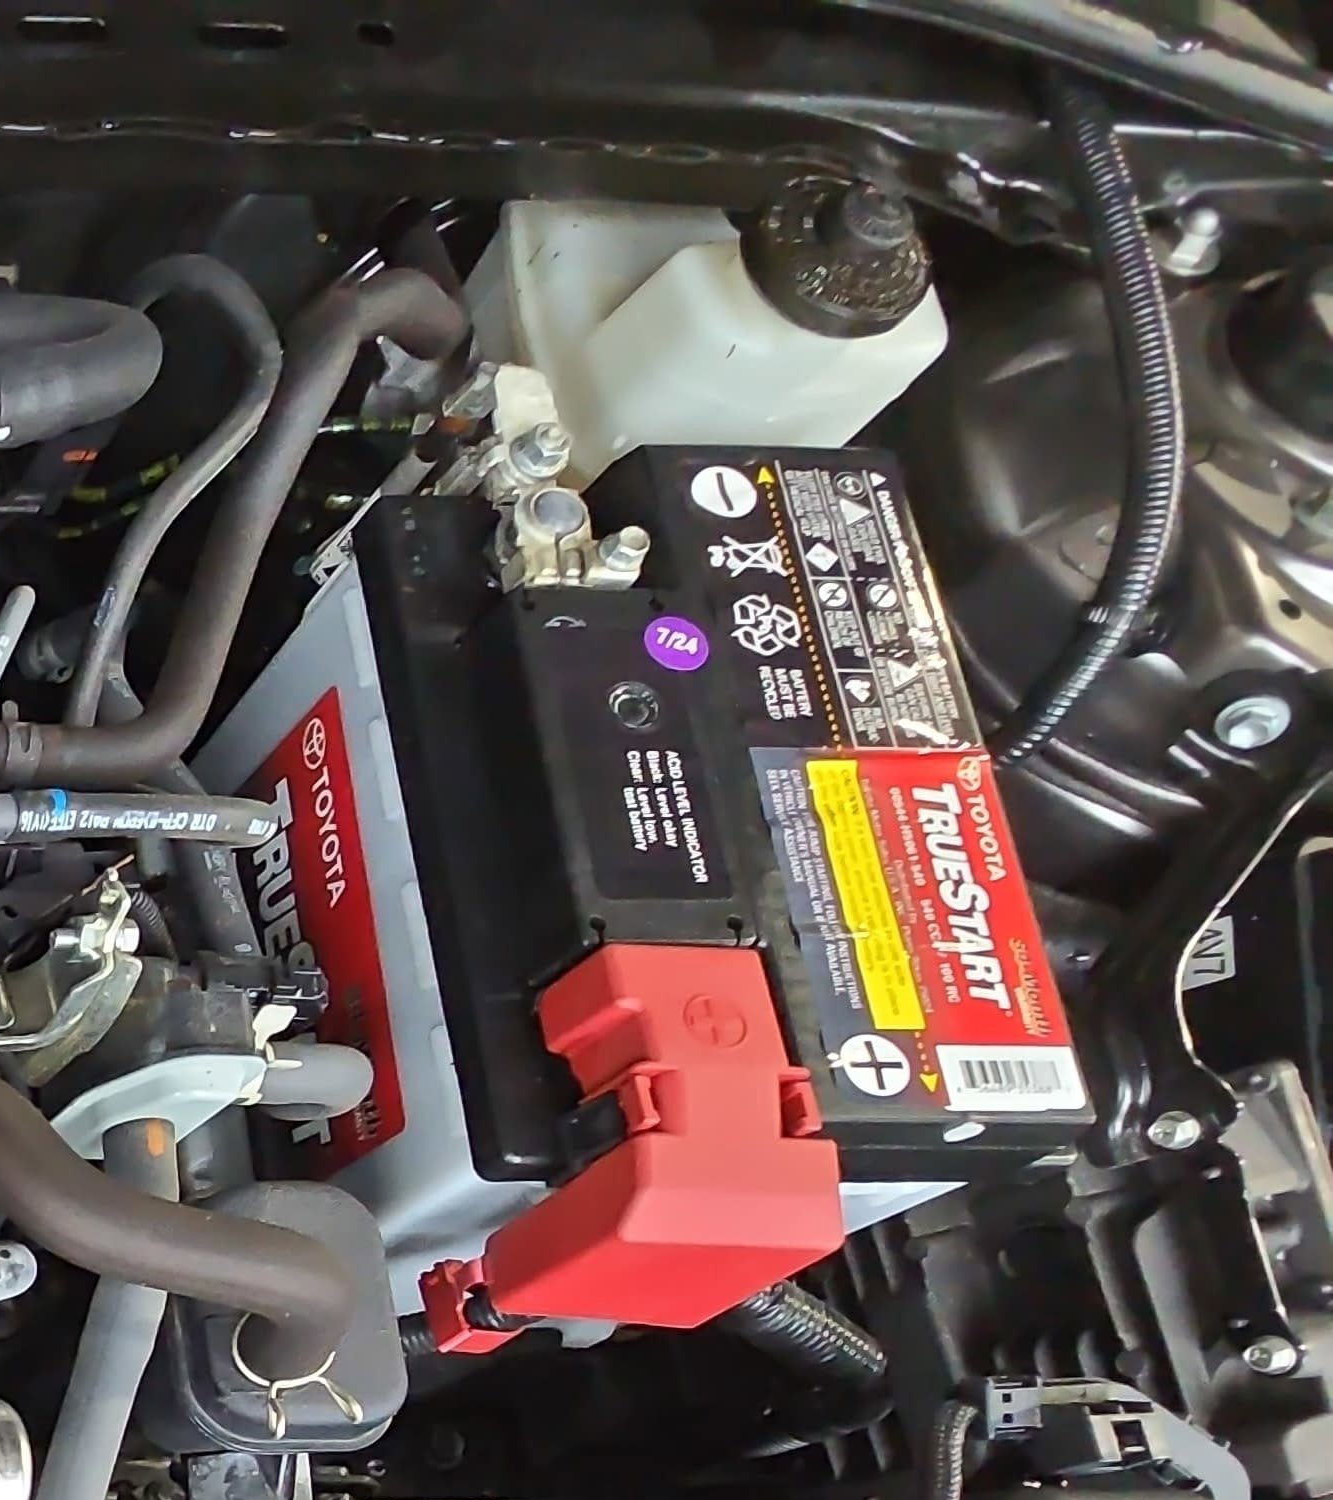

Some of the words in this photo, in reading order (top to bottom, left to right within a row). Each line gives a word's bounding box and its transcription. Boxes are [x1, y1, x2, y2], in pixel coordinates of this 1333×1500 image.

[655, 626, 698, 654] 7/24
[757, 665, 782, 721] RECYCLED
[773, 667, 793, 703] MUST
[789, 668, 813, 717] BATTERY
[781, 702, 796, 719] BE
[664, 748, 684, 780] ACID
[670, 779, 692, 816] LEVEL
[306, 765, 346, 907] TOYOTA
[680, 817, 709, 884] INDICATOR
[965, 794, 1008, 880] TOYOTA
[938, 963, 955, 982] 100
